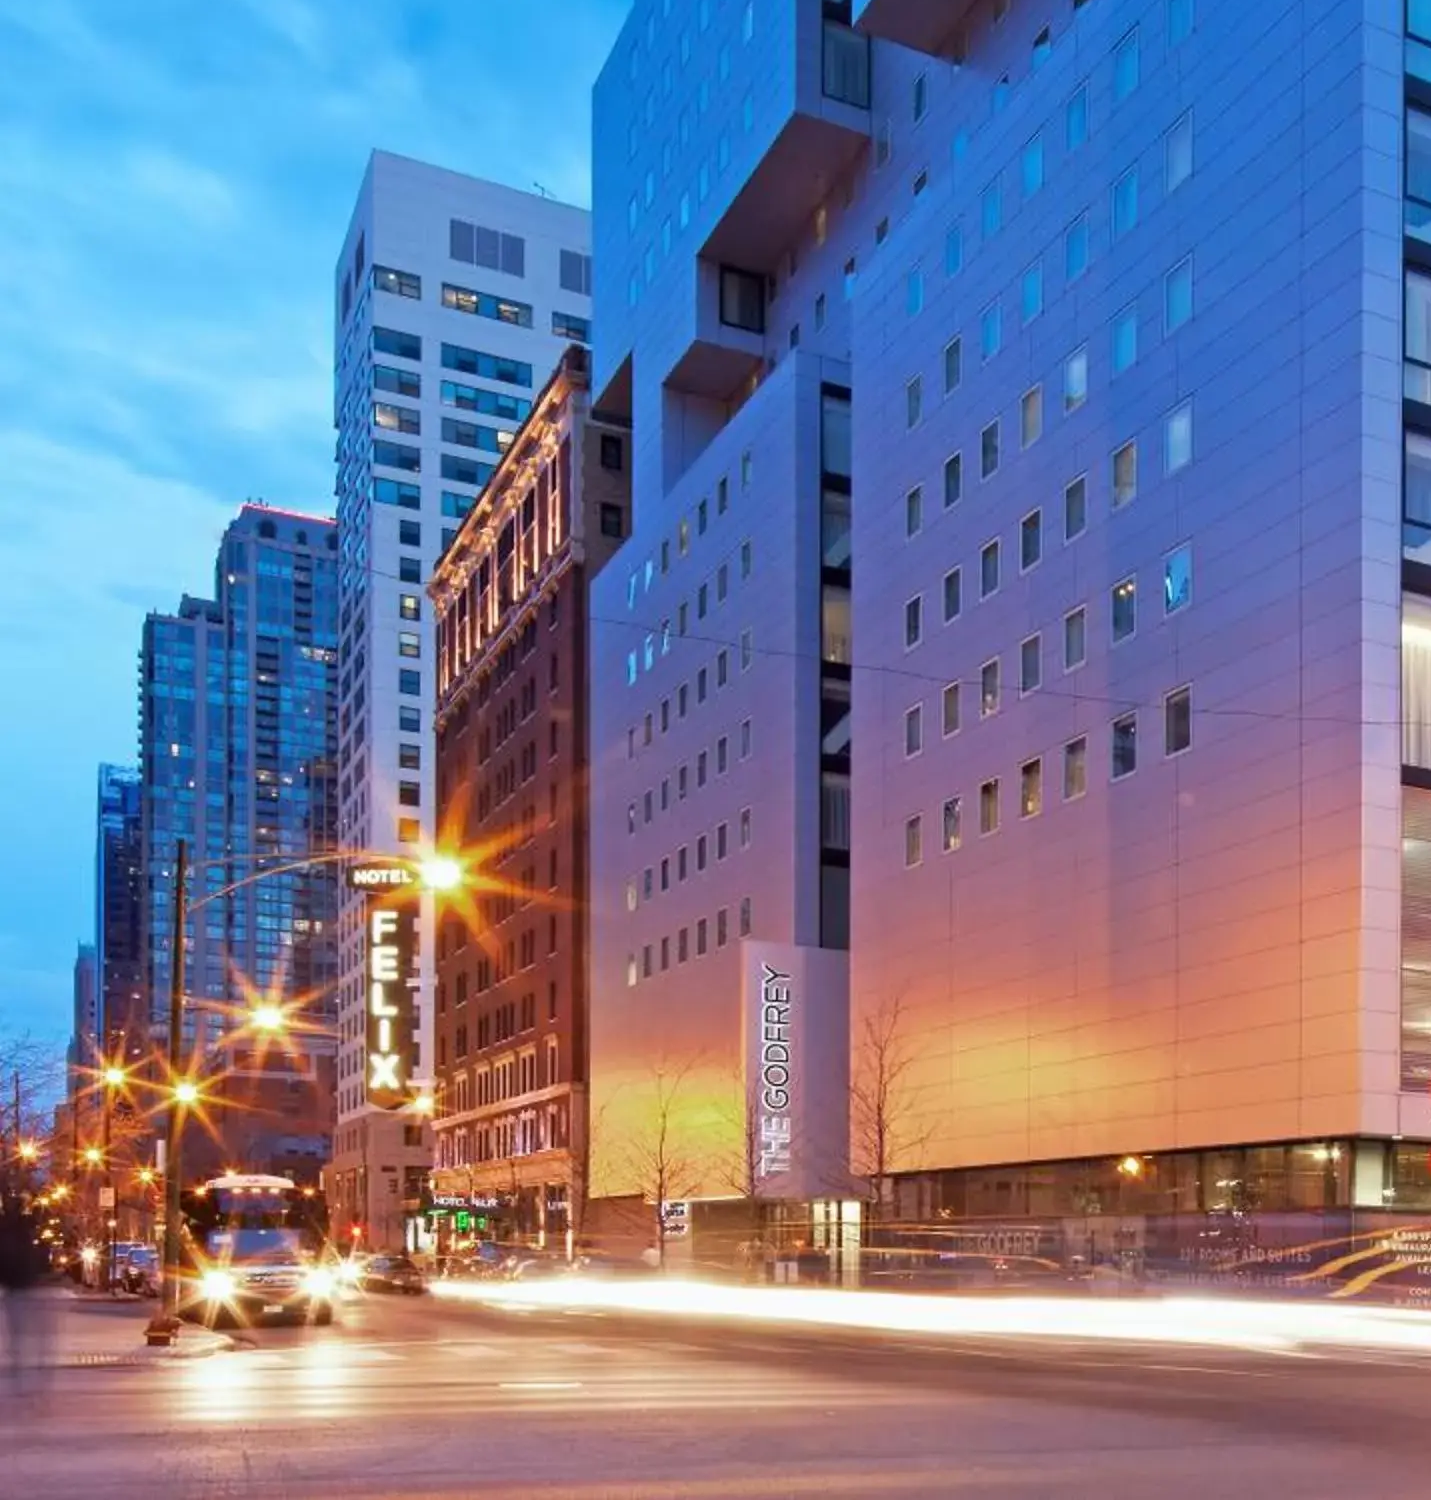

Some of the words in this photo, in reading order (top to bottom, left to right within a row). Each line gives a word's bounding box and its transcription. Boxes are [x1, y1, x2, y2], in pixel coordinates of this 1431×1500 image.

[353, 869, 413, 885] HOTEL
[369, 910, 400, 1089] FELIX
[762, 963, 792, 1111] GODFREY
[761, 1116, 791, 1177] THE
